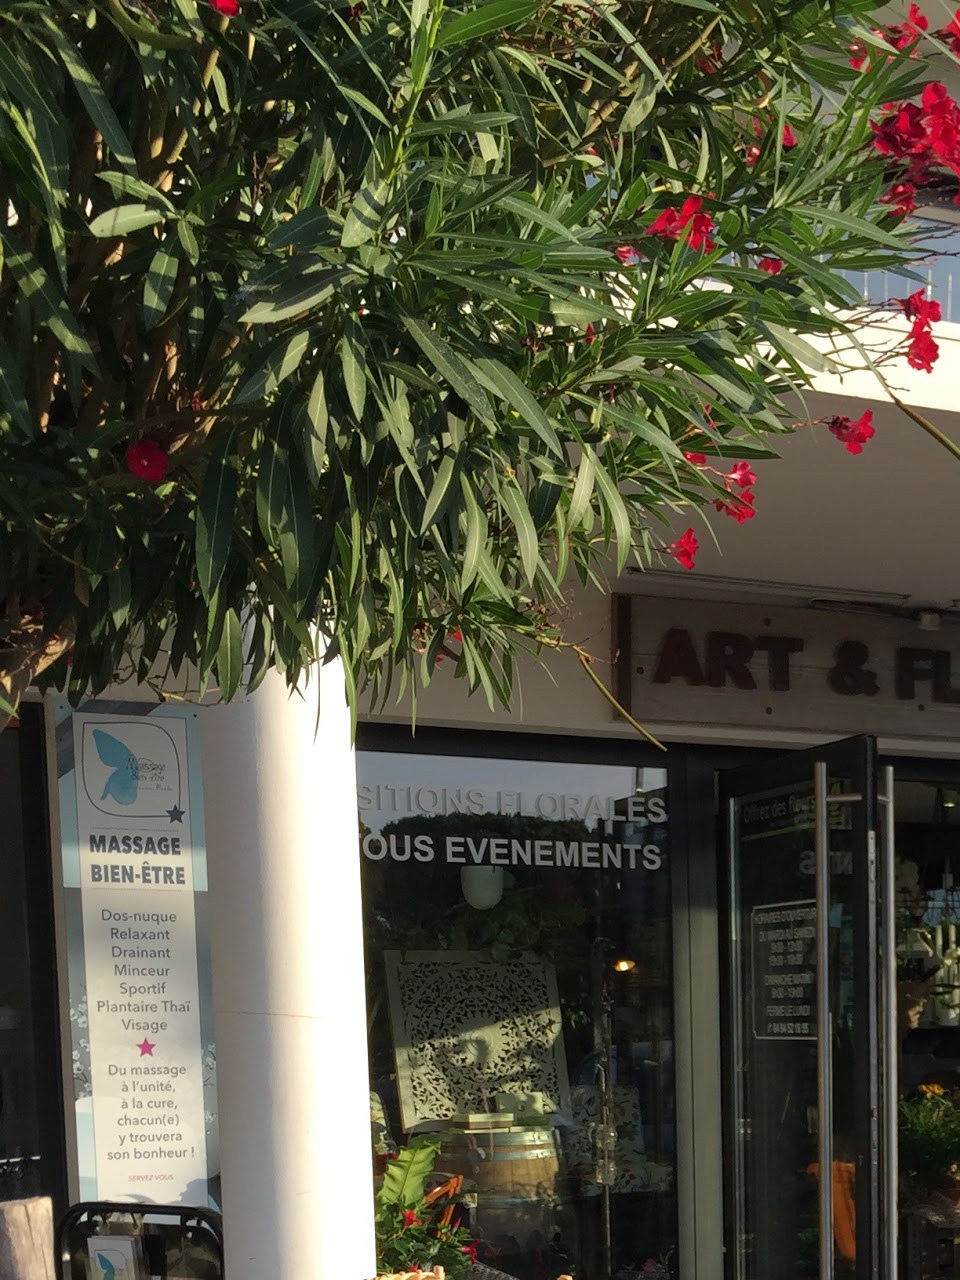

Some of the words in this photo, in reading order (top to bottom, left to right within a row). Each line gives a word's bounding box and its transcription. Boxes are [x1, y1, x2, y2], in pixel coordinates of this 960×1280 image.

[653, 628, 804, 692] ART
[826, 640, 880, 696] &
[497, 791, 669, 824] FLORALES
[89, 834, 181, 856] MASSAGE
[359, 833, 435, 862] OUS
[446, 836, 662, 871] EVENEMENTS
[91, 861, 186, 885] BIEN-ÊTRE
[101, 909, 177, 925] Dos-nuque
[110, 927, 170, 940] Relaxant
[111, 946, 171, 959] Drainant
[114, 964, 170, 977] Minceur
[120, 982, 166, 997] Sportif
[97, 1000, 158, 1013] Plantaire
[161, 1000, 191, 1013] Thaï
[121, 1018, 168, 1034] Visage
[108, 1064, 127, 1076] Du
[131, 1066, 187, 1078] massage
[121, 1081, 129, 1093] à
[121, 1098, 129, 1109] à
[132, 1097, 143, 1109] la
[147, 1099, 178, 1110] cure,
[117, 1114, 180, 1127] chacun(e)
[118, 1134, 126, 1146] y
[130, 1132, 183, 1143] trouvera
[107, 1151, 130, 1161] son
[134, 1146, 188, 1159] bonheur
[191, 1146, 195, 1158] !
